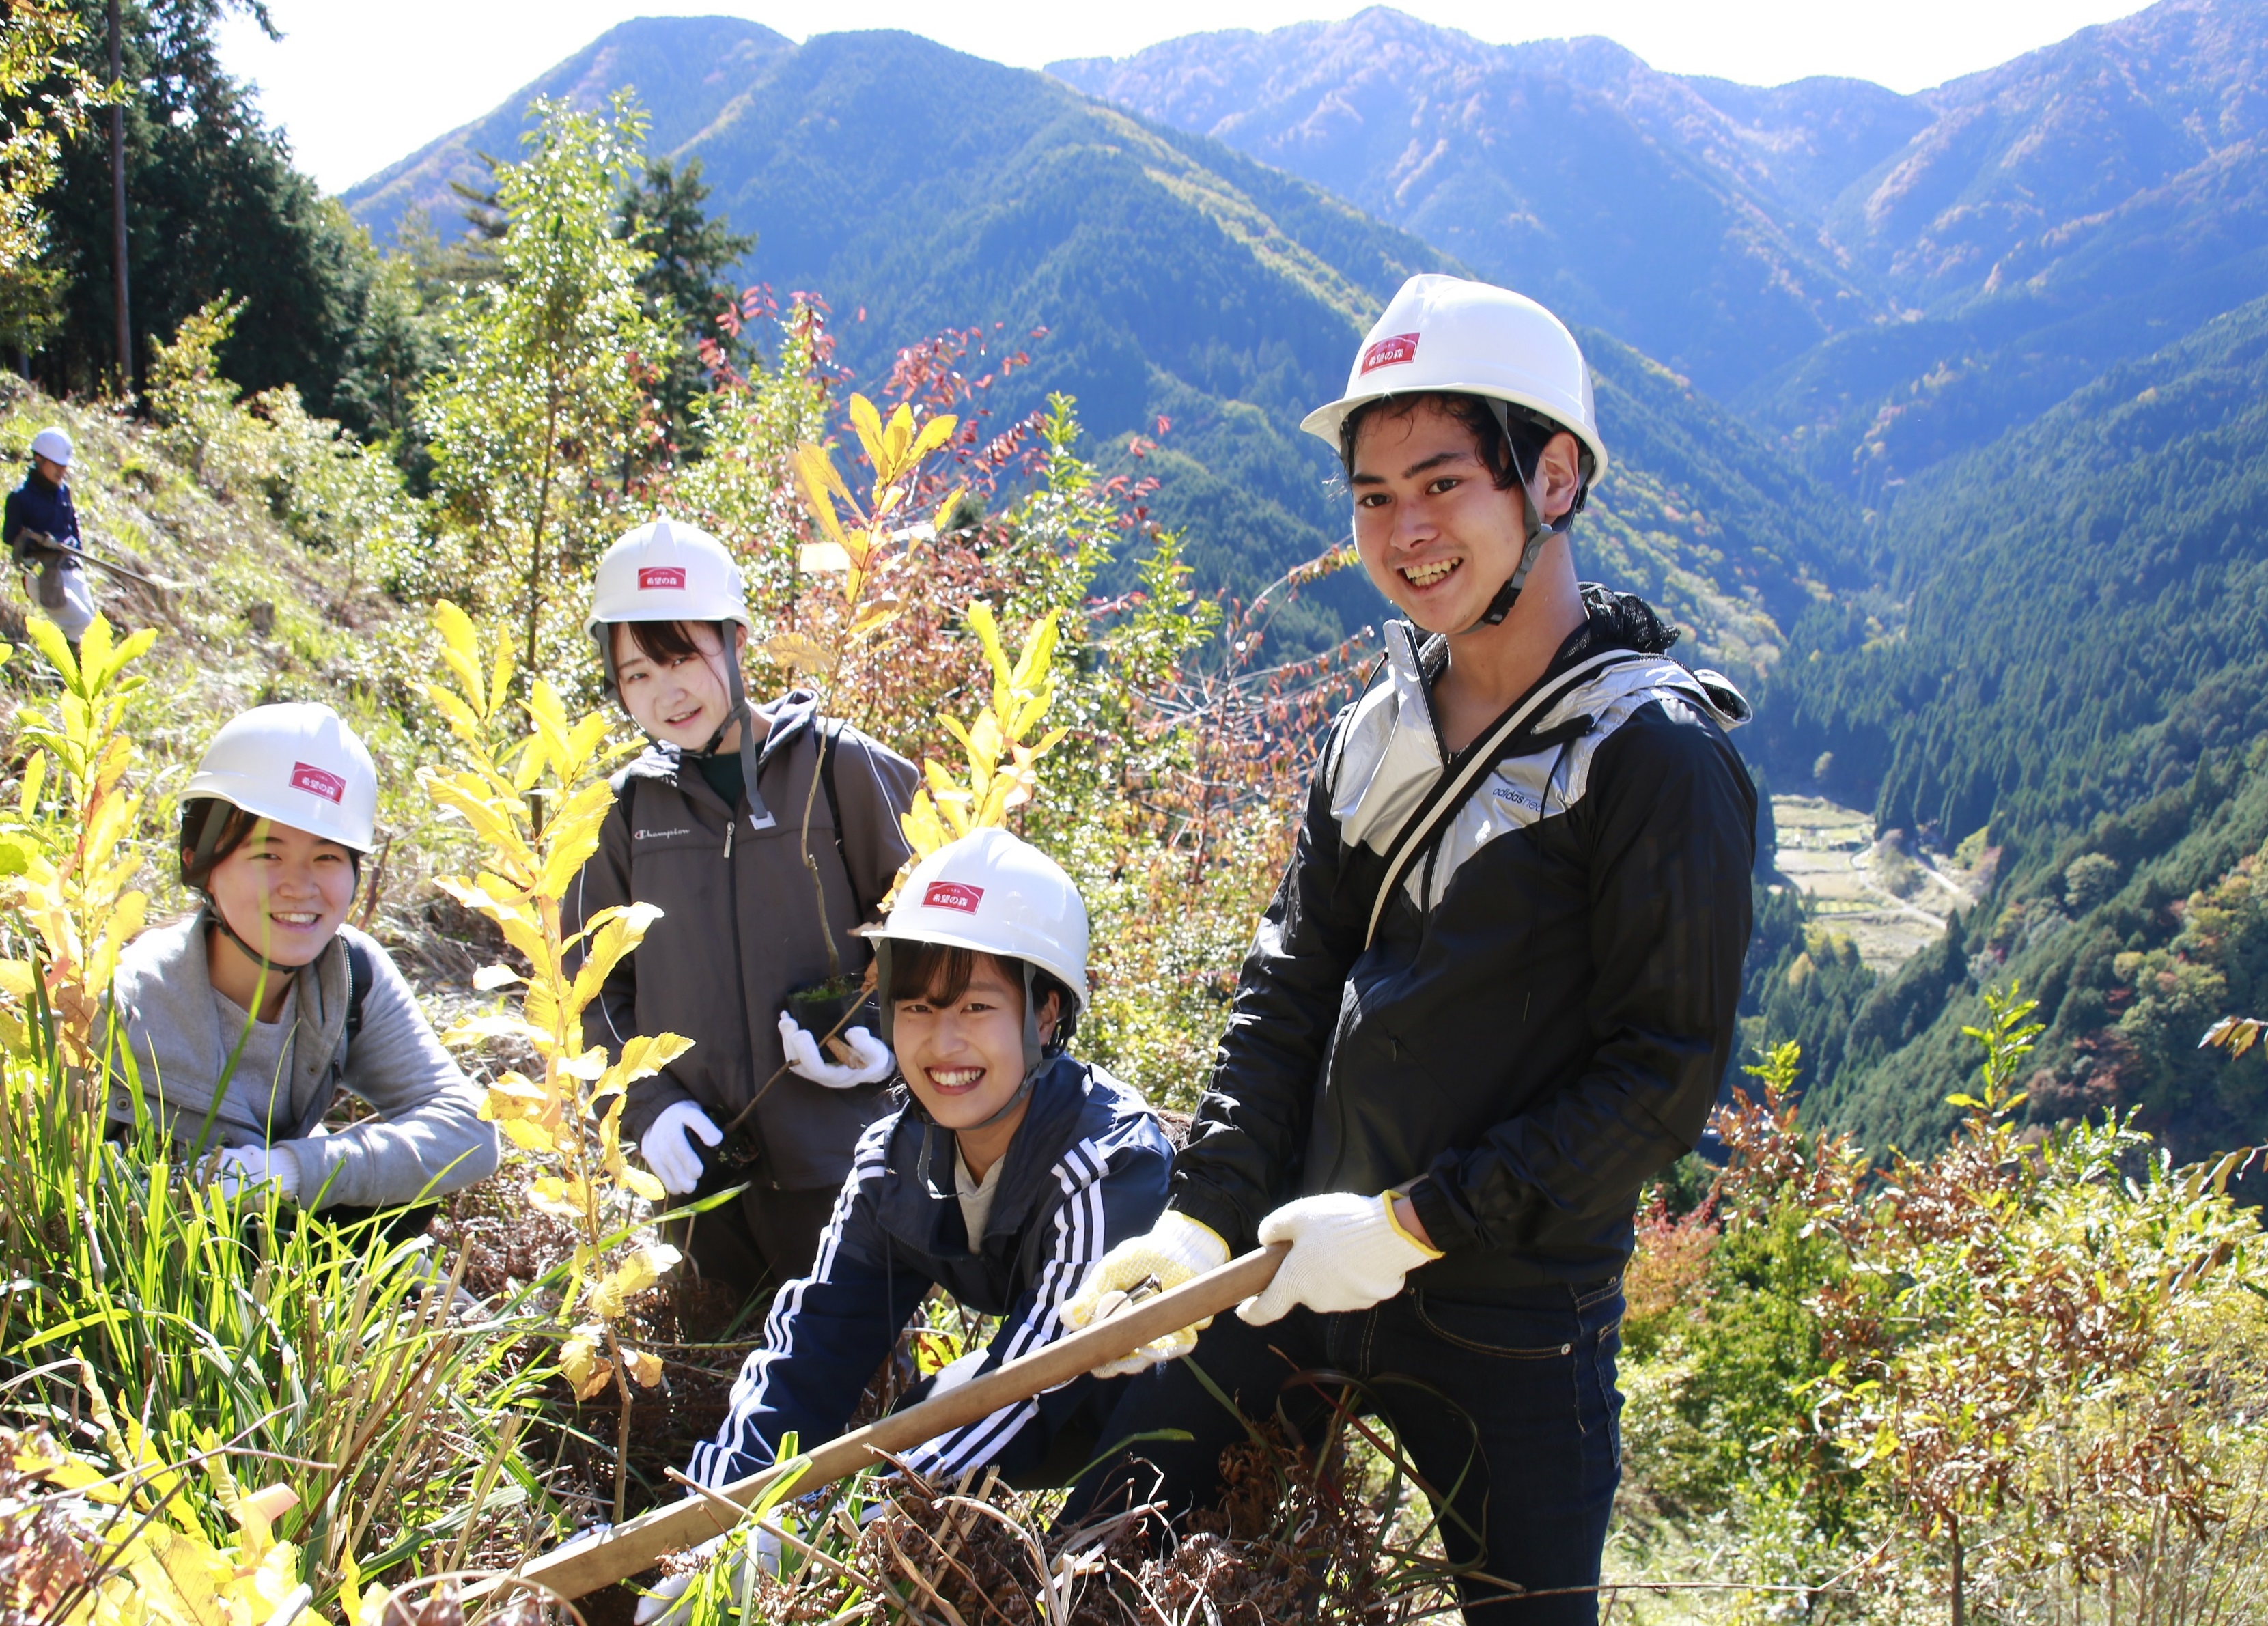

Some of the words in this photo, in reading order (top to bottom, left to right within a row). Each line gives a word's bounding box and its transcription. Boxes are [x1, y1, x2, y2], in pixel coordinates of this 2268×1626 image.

[1492, 788, 1524, 804] adidas
[634, 828, 690, 840] Champion
[932, 893, 968, 907] 希望の森
